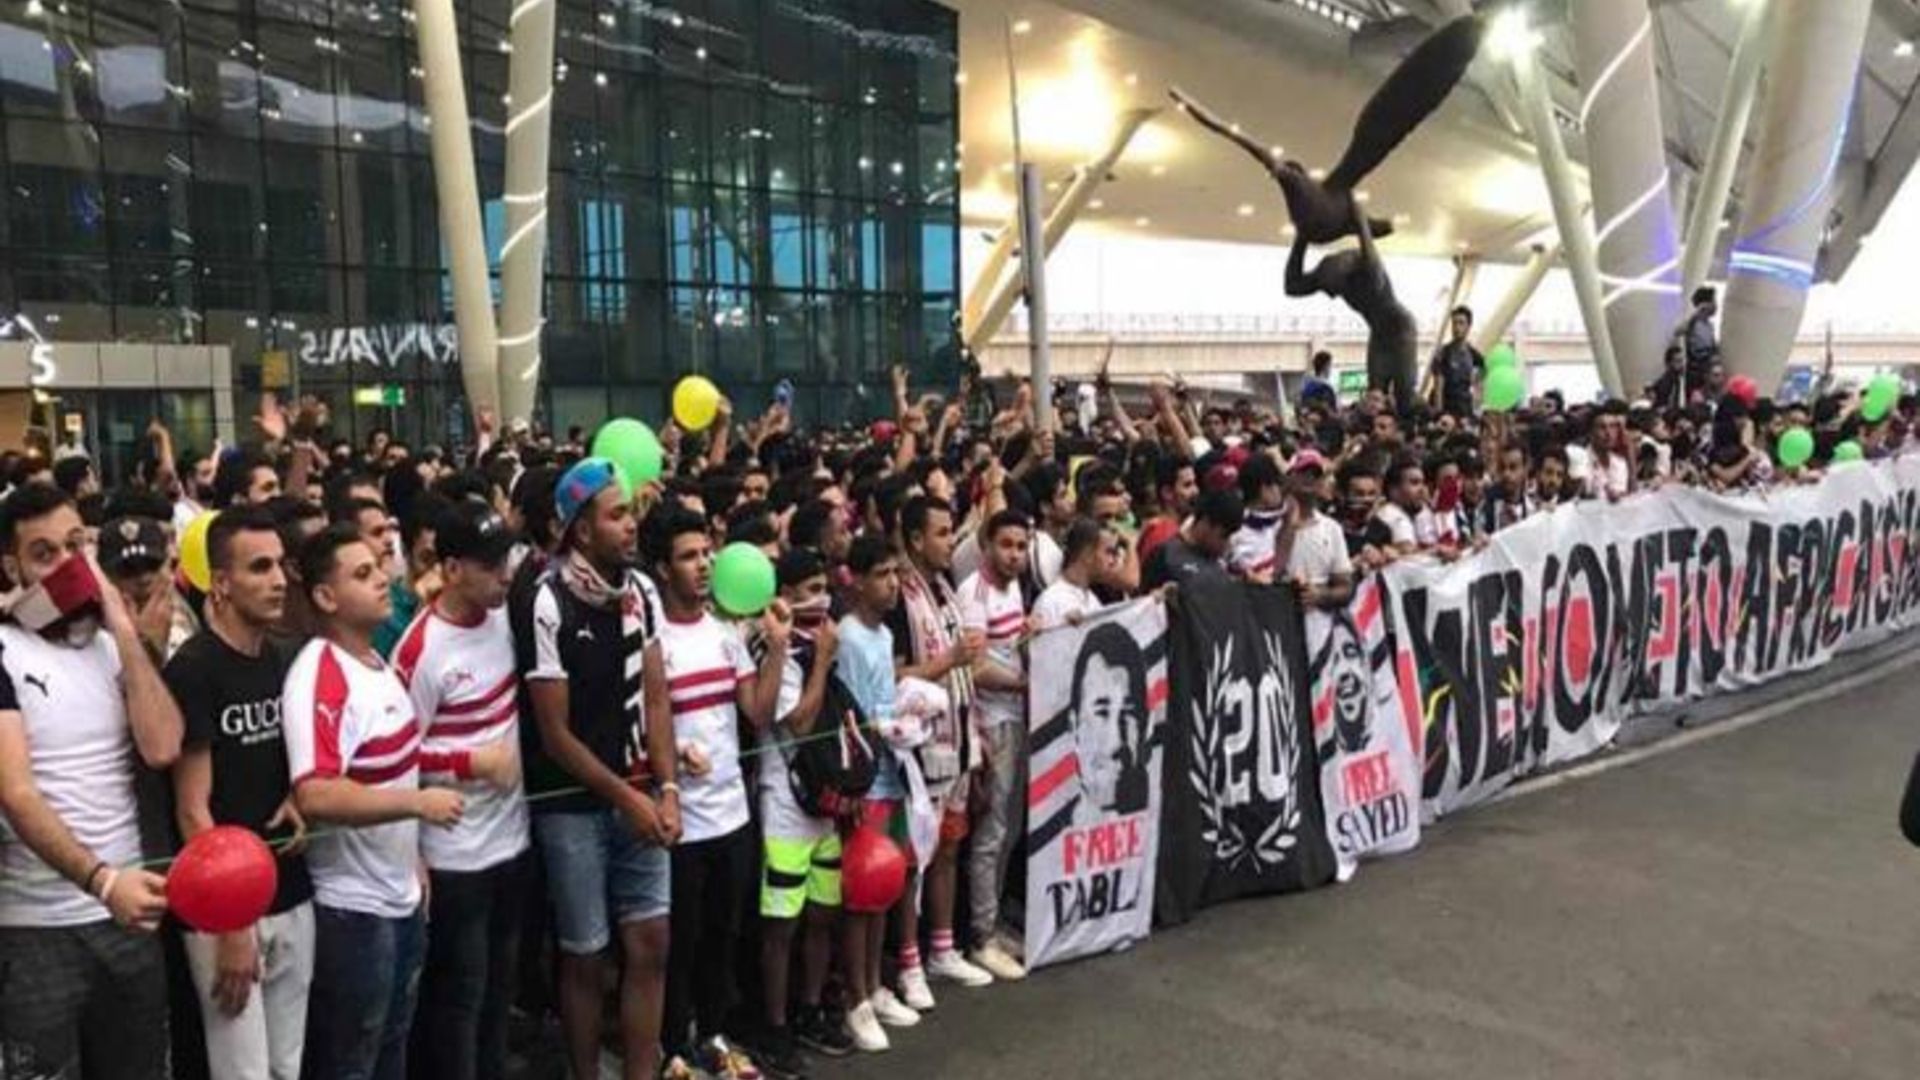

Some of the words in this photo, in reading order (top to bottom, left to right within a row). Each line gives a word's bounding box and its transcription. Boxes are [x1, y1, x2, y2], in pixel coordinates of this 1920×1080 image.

[31, 343, 55, 386] 5
[1667, 526, 1731, 697] TO
[1222, 672, 1291, 806] 20
[1046, 868, 1142, 930] TABL
